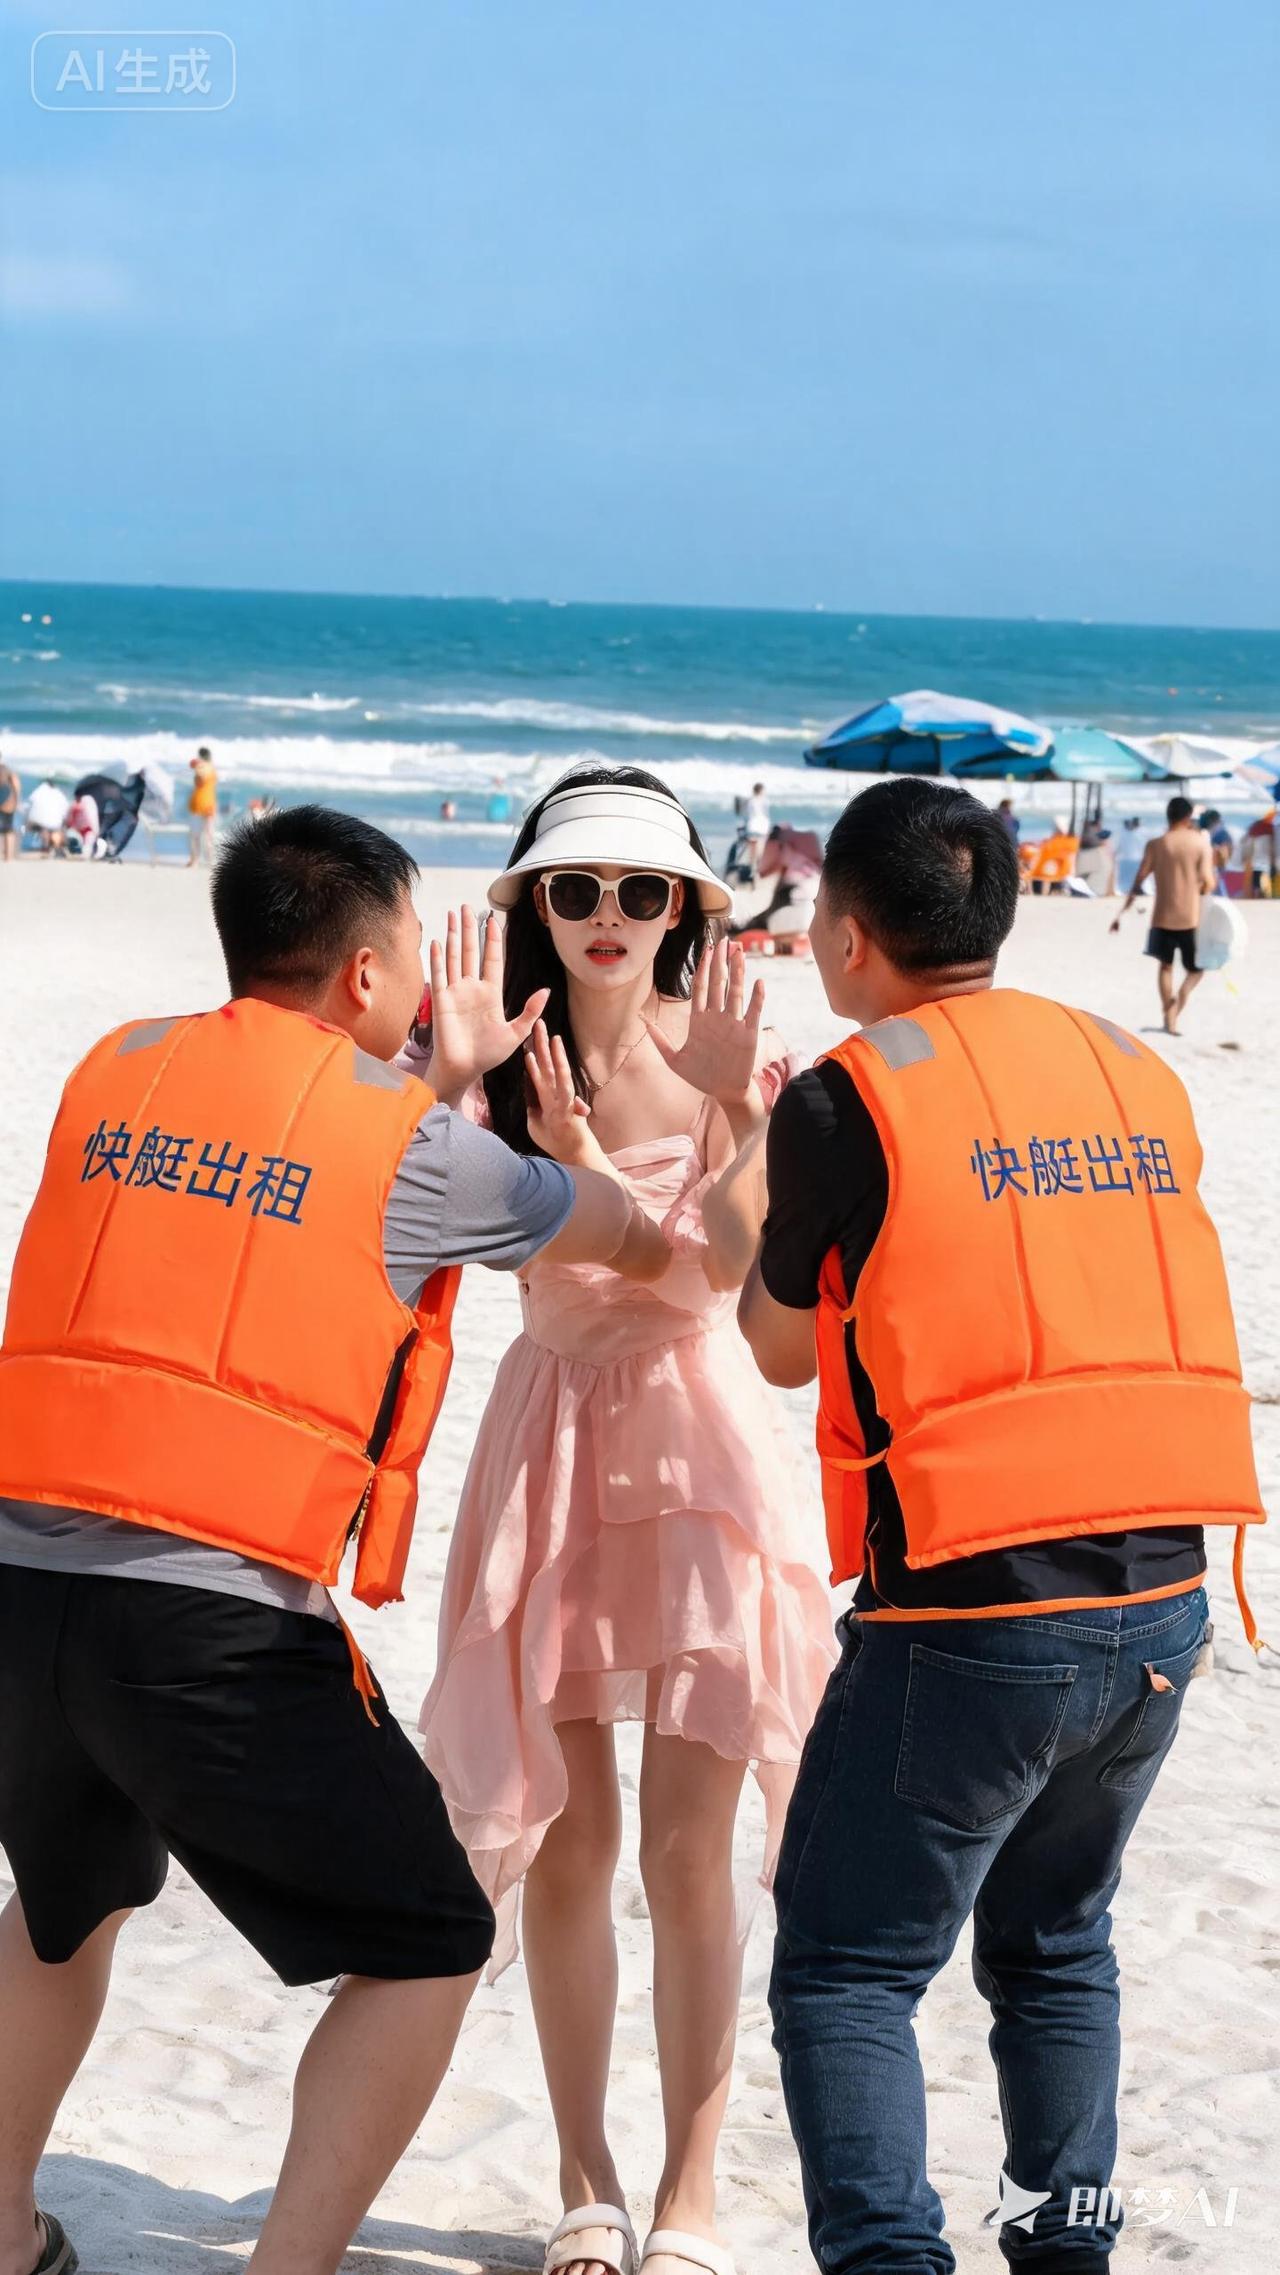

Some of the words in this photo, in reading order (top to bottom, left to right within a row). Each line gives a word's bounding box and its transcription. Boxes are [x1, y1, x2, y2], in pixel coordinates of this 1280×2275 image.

[81, 1119, 312, 1225] 快艇出租
[970, 1134, 1181, 1201] 快艇出租
